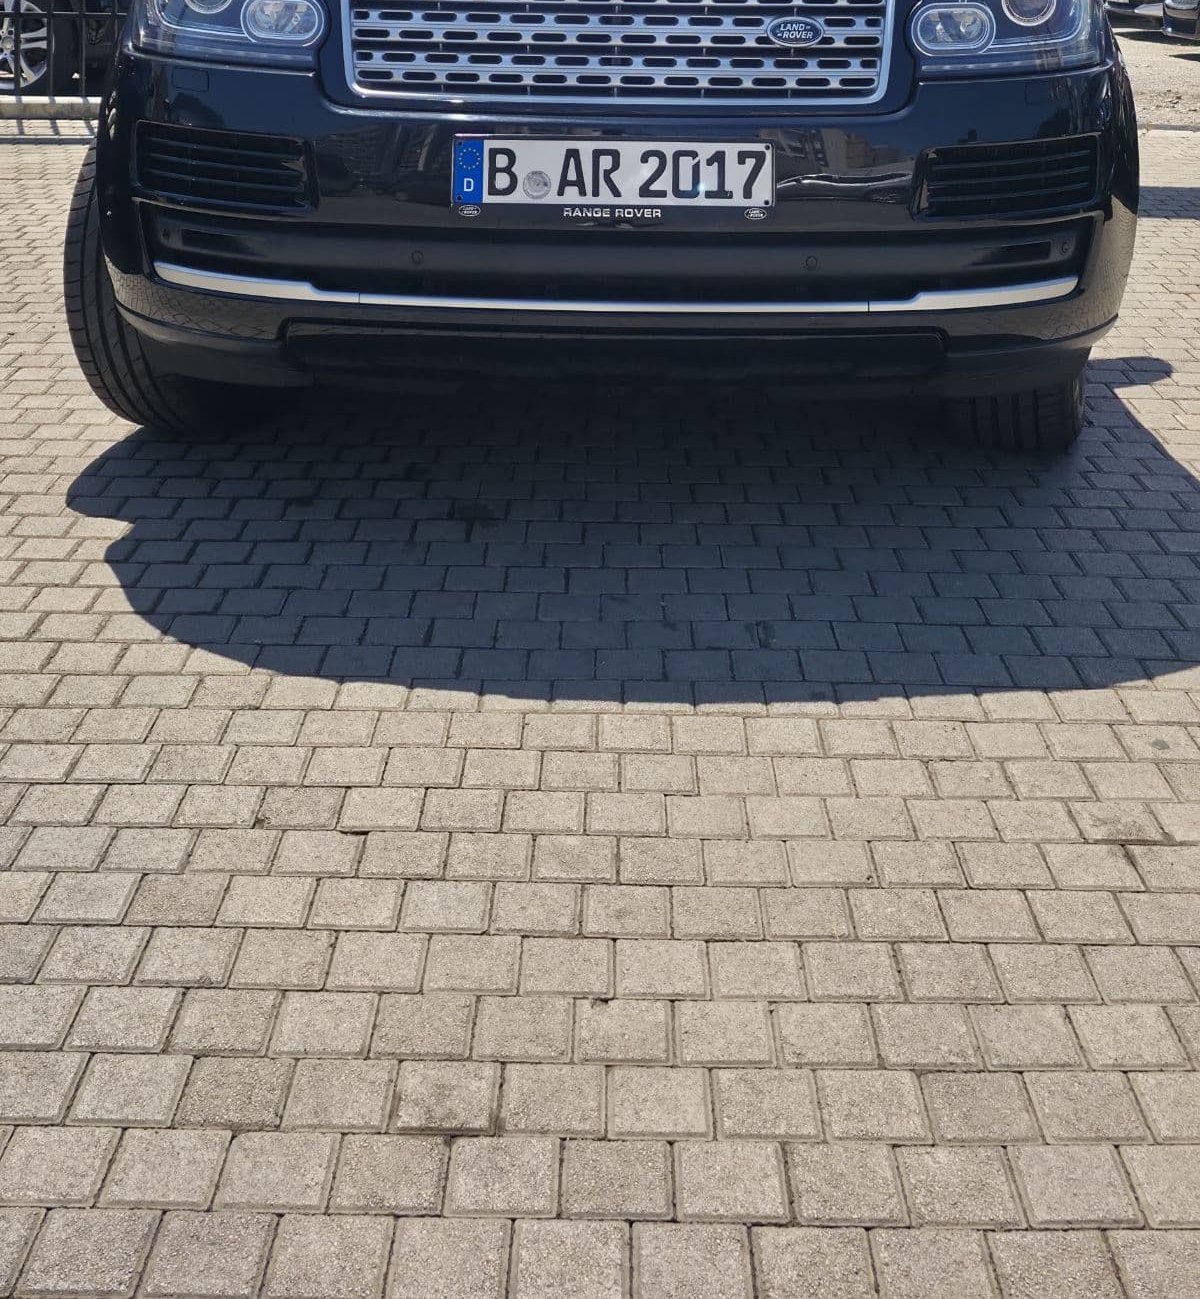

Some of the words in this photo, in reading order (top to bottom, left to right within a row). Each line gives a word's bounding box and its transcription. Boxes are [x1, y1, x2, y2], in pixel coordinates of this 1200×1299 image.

[780, 23, 806, 31] LAND
[782, 31, 814, 39] ROVER
[487, 147, 518, 197] B
[556, 148, 622, 198] AR
[638, 150, 767, 200] 2017
[463, 178, 475, 192] D
[562, 207, 611, 218] RANGE
[614, 208, 662, 219] ROVER
